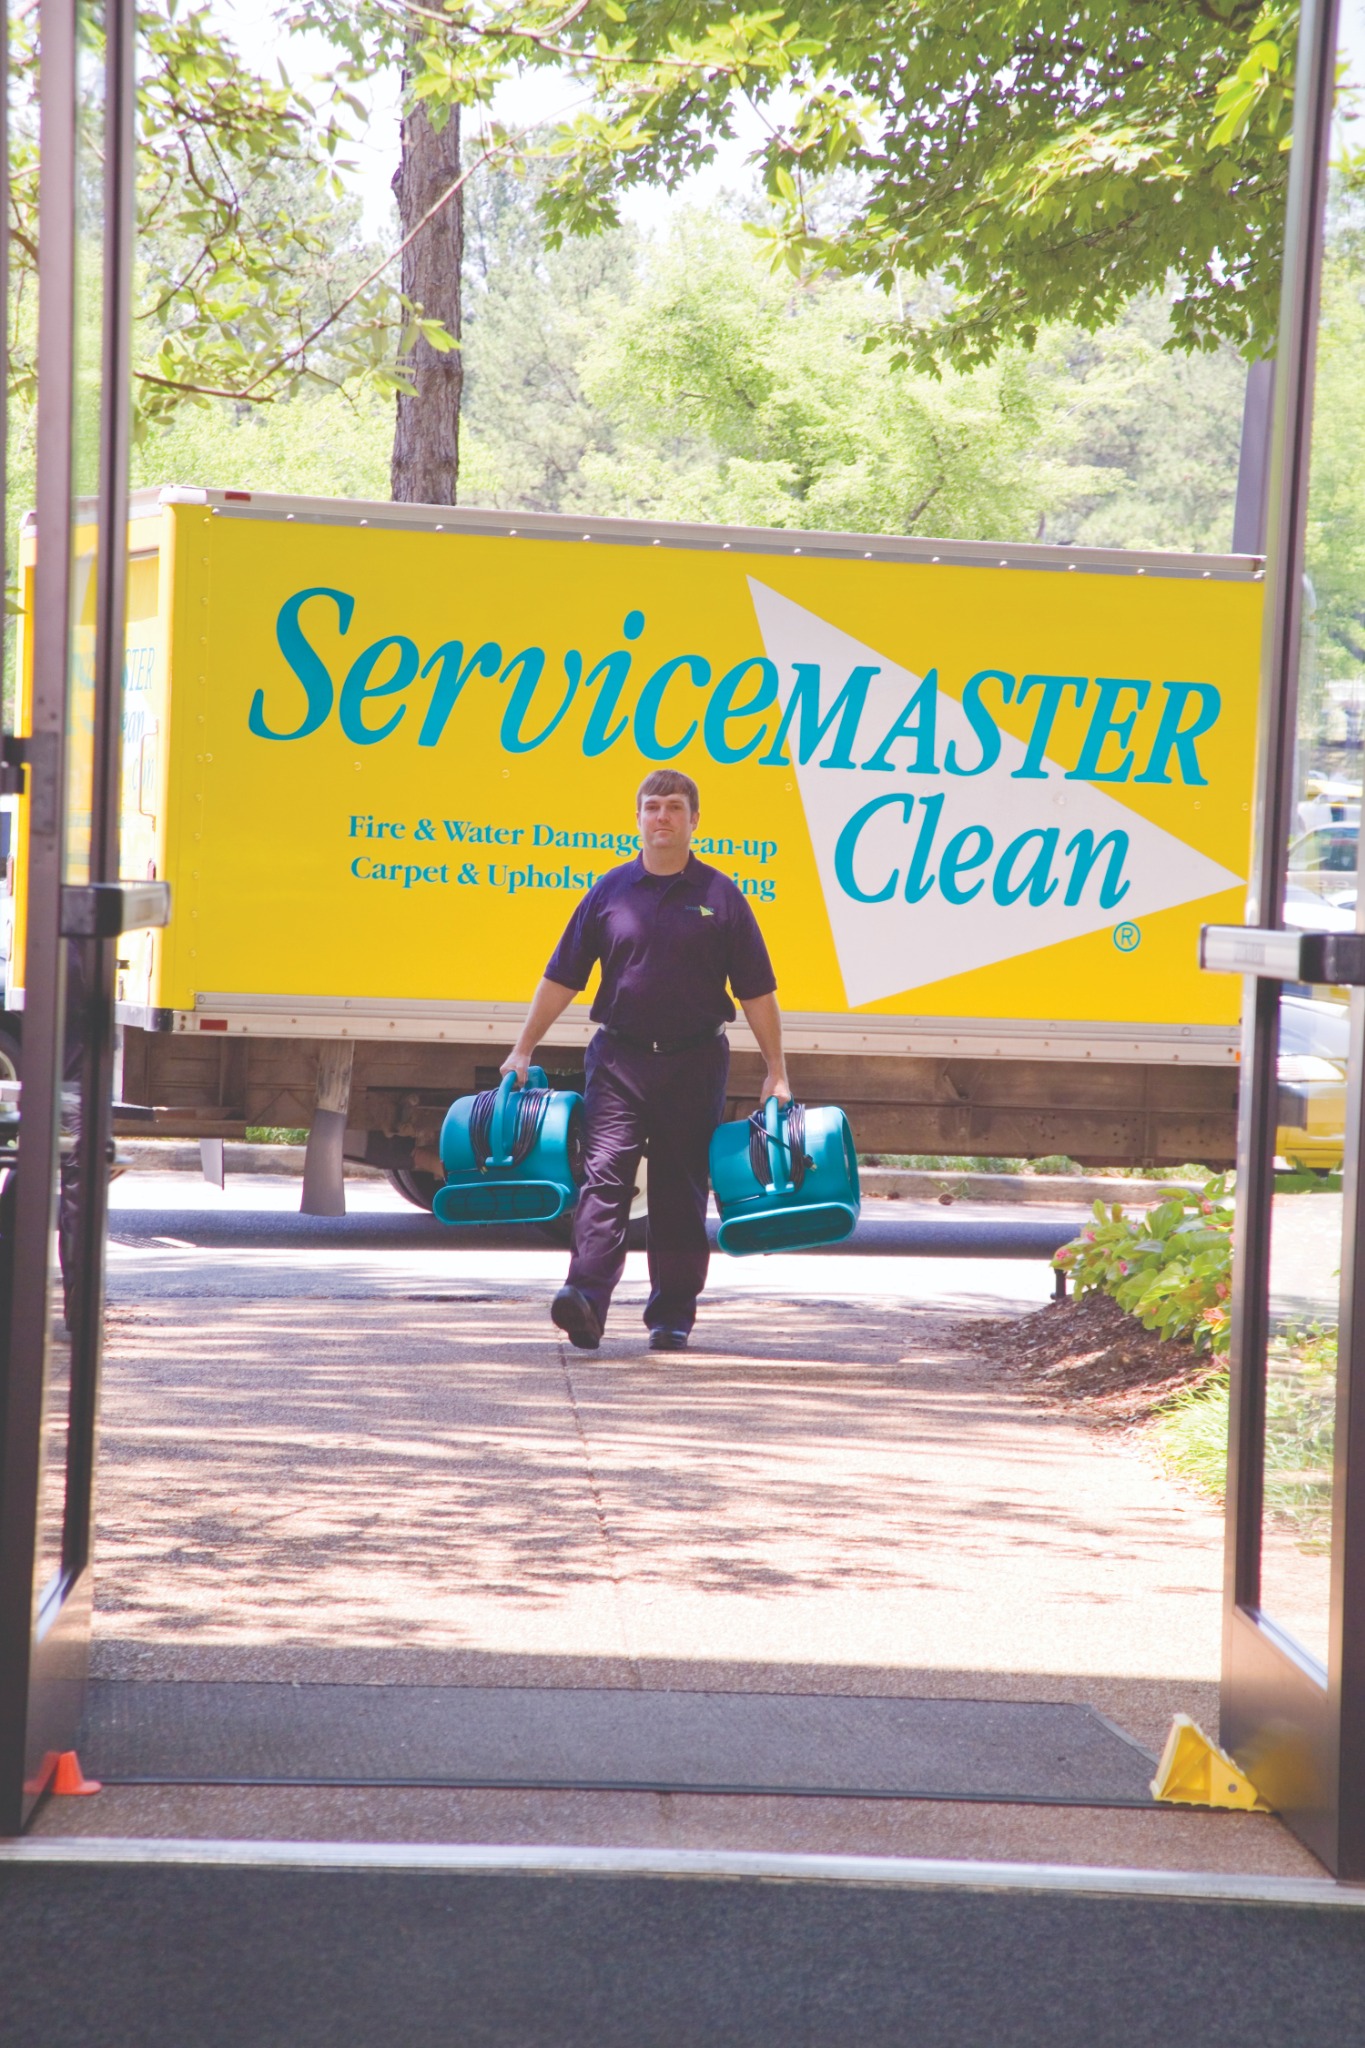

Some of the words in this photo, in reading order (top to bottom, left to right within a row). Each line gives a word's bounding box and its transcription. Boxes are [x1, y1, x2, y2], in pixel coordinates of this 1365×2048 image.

[348, 815, 406, 840] Fire
[413, 818, 436, 842] &
[443, 820, 525, 846] Water
[532, 824, 643, 857] Damage
[689, 836, 778, 864] ean-up
[833, 791, 1132, 911] Clean
[350, 856, 449, 889] Carpet
[456, 862, 479, 886] &
[487, 864, 605, 894] Upholst
